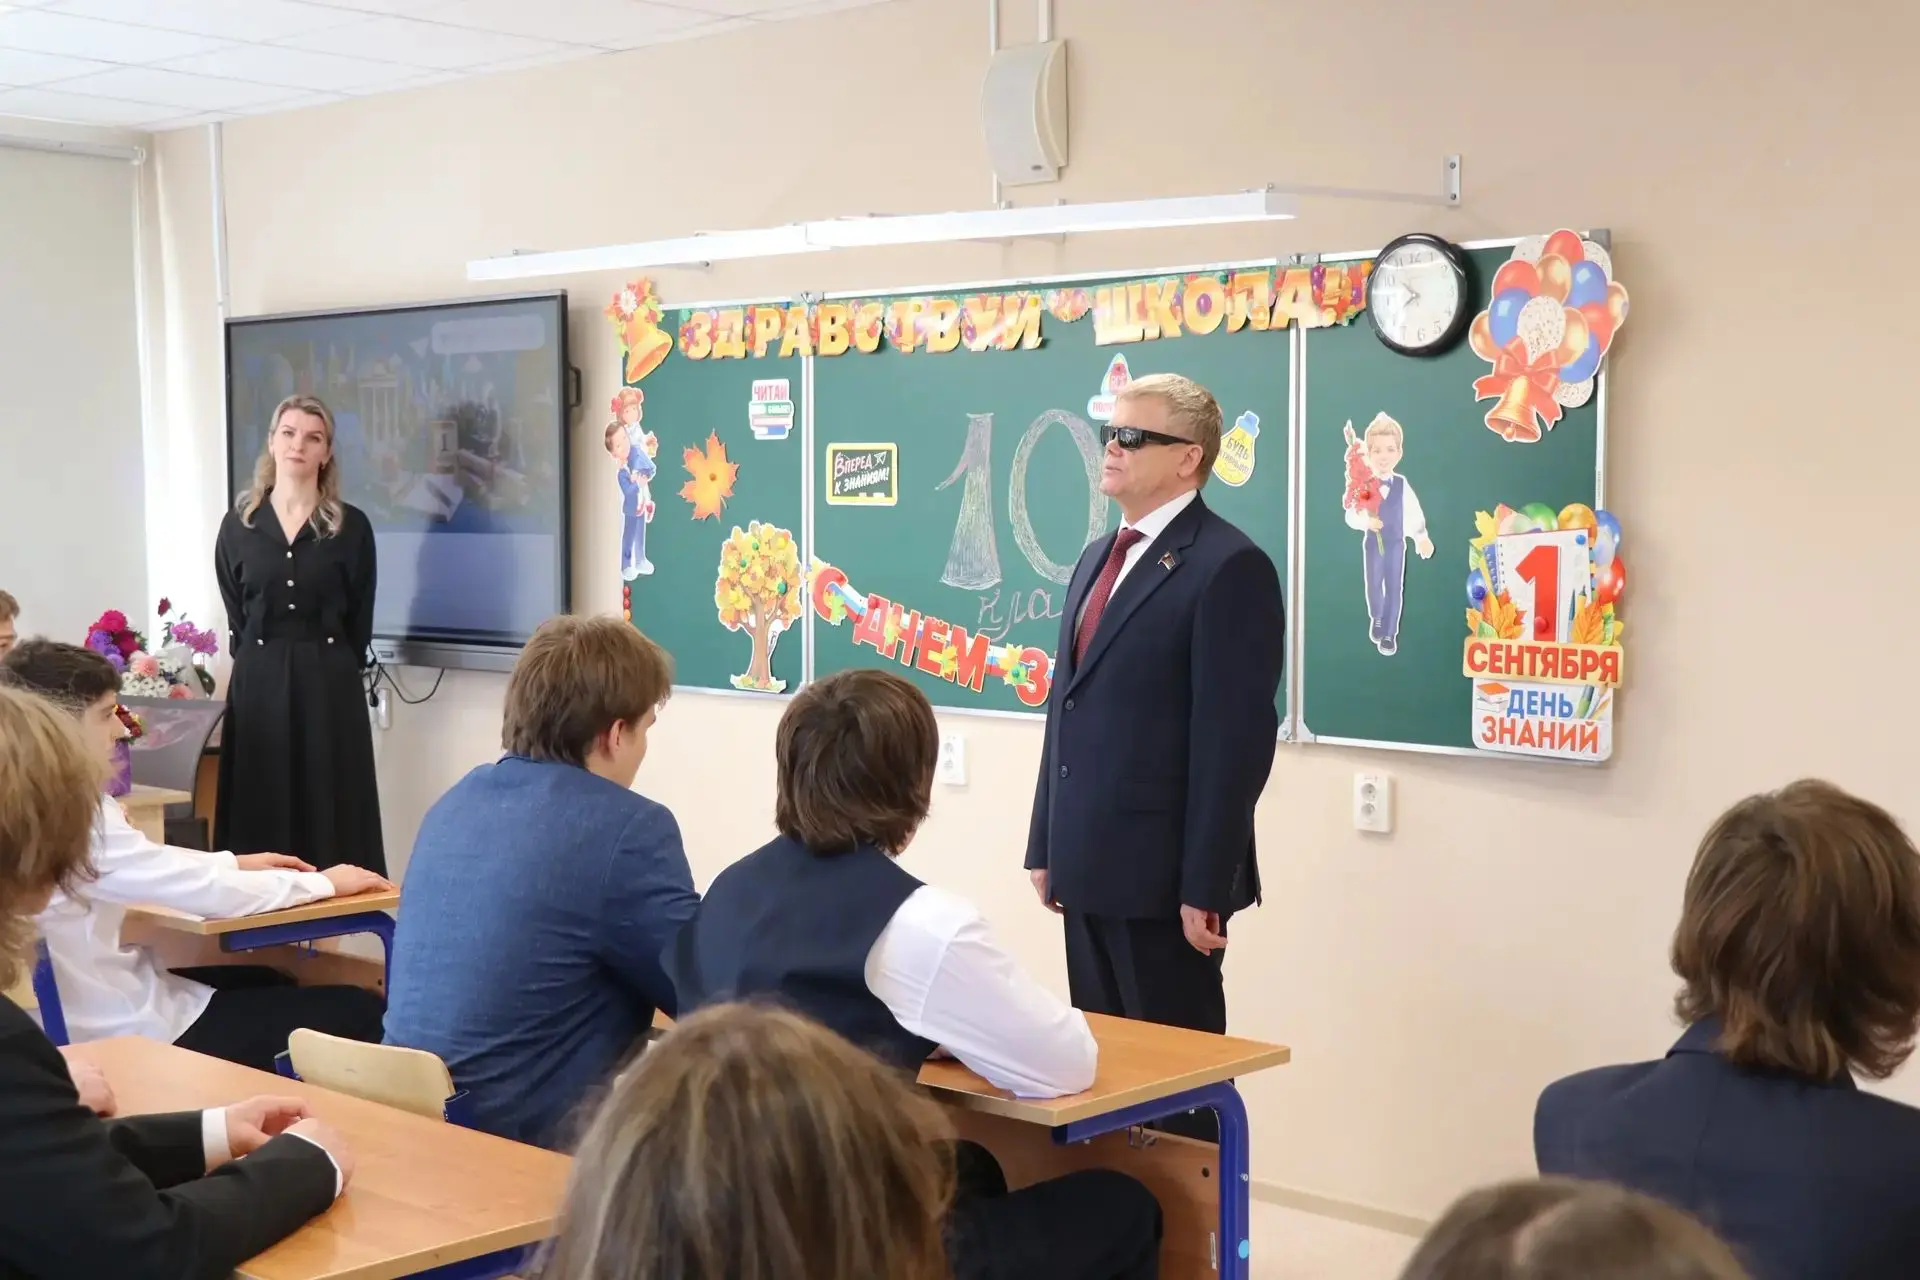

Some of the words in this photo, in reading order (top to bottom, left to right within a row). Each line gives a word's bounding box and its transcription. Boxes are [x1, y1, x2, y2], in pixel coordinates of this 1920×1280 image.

[1095, 267, 1341, 346] ШКОЛА!
[1227, 437, 1249, 460] БУДЬ
[843, 467, 890, 492] ЗНАНИЯМ!
[935, 409, 1109, 590] 10
[977, 588, 1065, 642] кла
[1515, 545, 1561, 641] 1
[812, 566, 849, 623] С
[1015, 647, 1051, 707] З
[1467, 641, 1620, 682] СЕНТЯБРЯ
[1506, 689, 1574, 719] ДЕНЬ
[1482, 715, 1599, 753] ЗНАНИЙ
